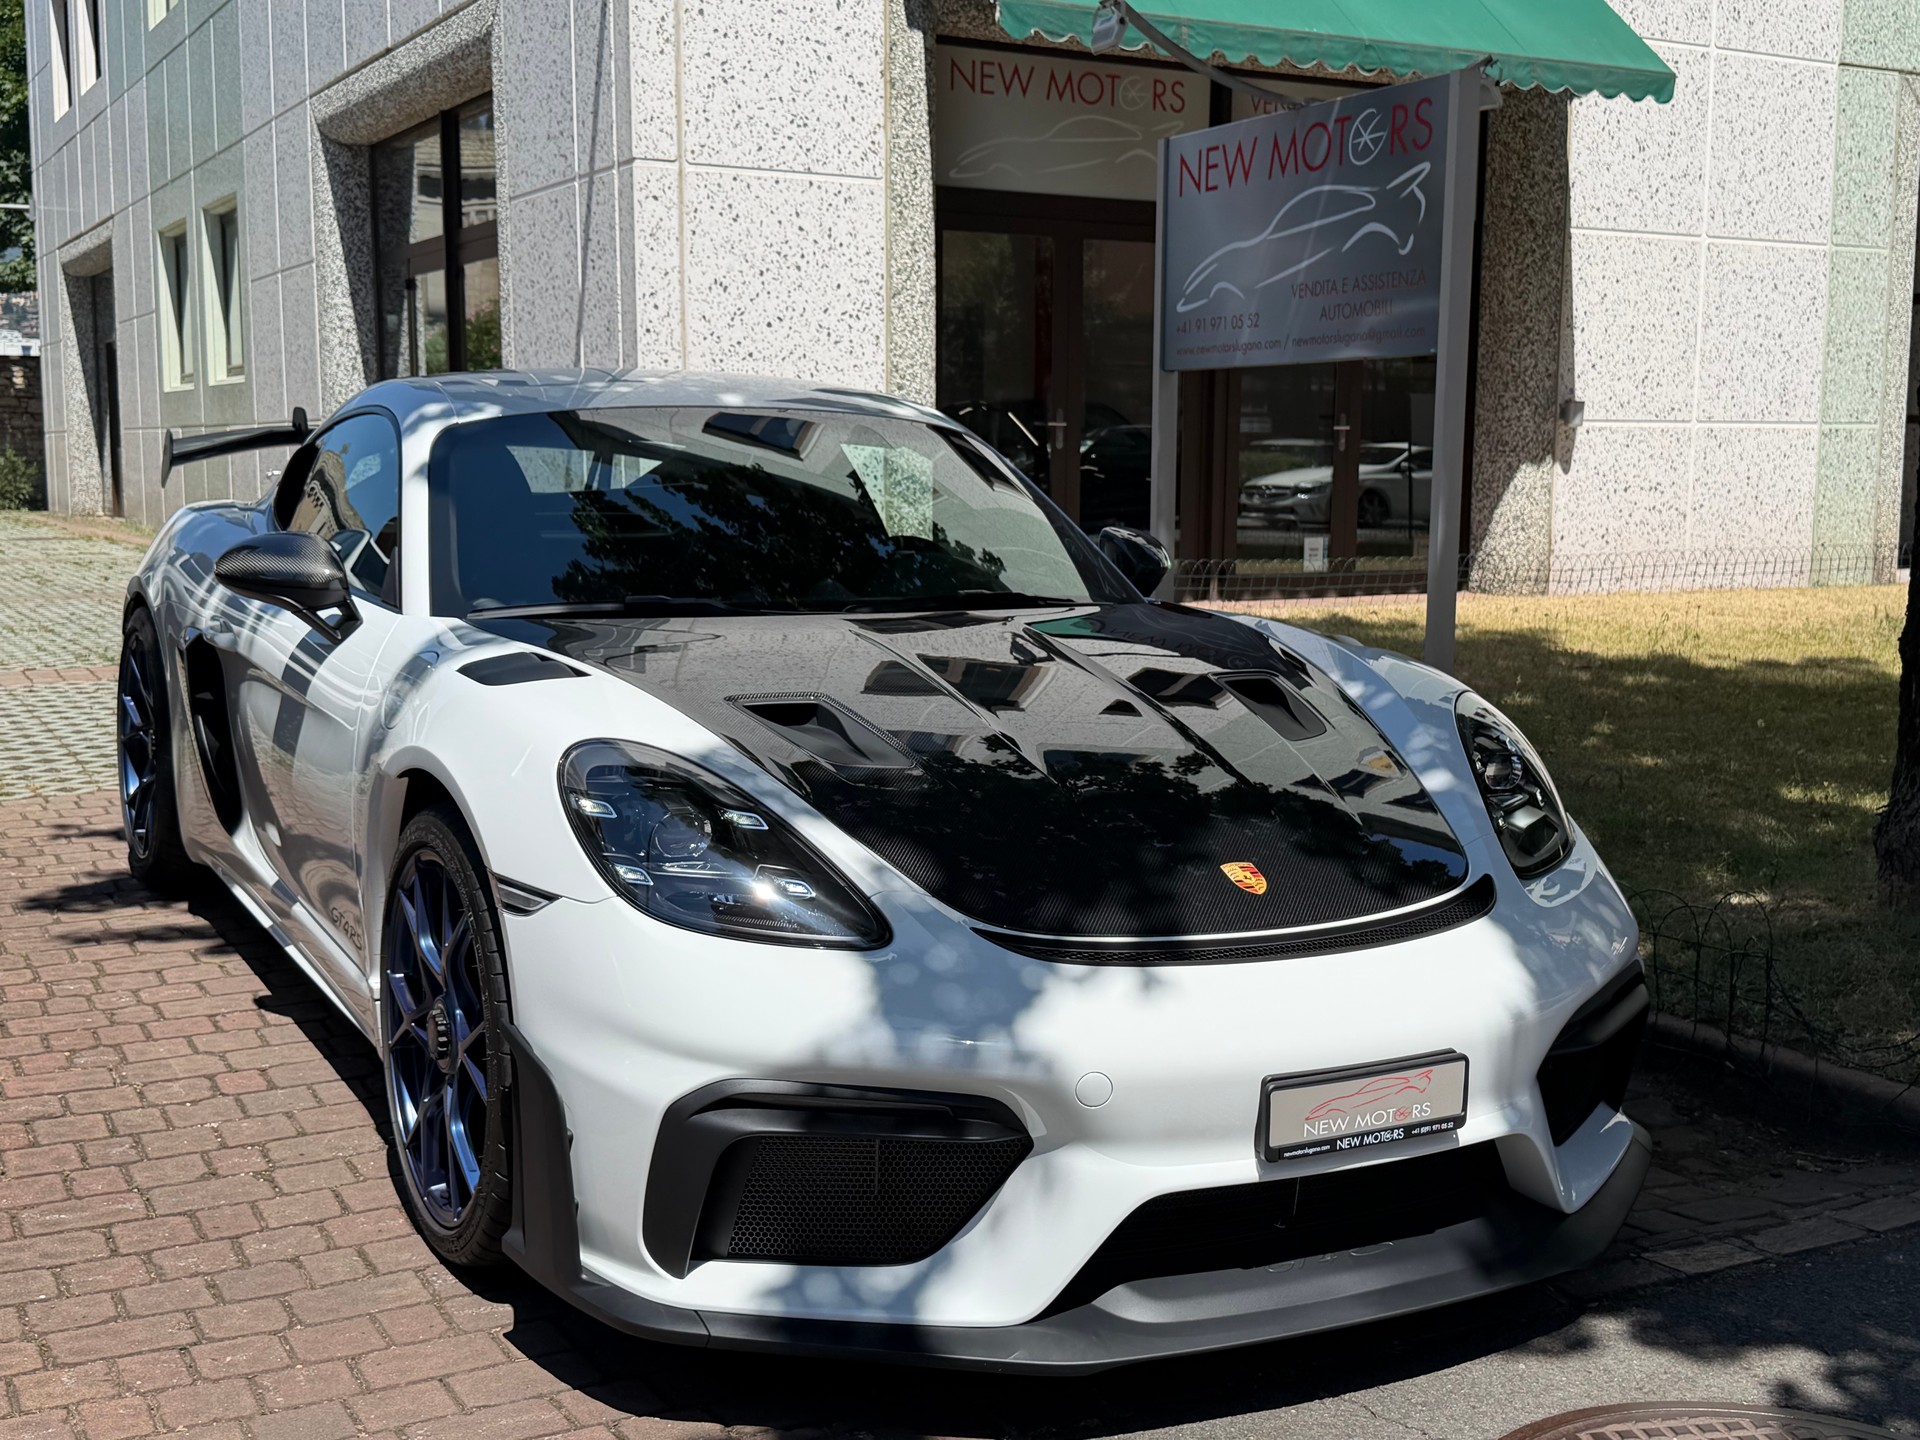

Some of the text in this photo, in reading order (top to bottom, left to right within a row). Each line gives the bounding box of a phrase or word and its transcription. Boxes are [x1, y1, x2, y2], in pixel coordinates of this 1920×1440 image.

[950, 57, 1186, 114] NEW MOTORS
[1178, 96, 1434, 198] NEW MOTORS
[1291, 268, 1427, 299] VENDITA E ASSISTENZA
[1176, 312, 1260, 334] +41 91 971 05 52
[1319, 299, 1394, 322] AUTOMOBILI
[1303, 1102, 1432, 1138] NEW MOTORS
[1336, 1135, 1362, 1150] NEW
[1363, 1128, 1404, 1146] MOTORS
